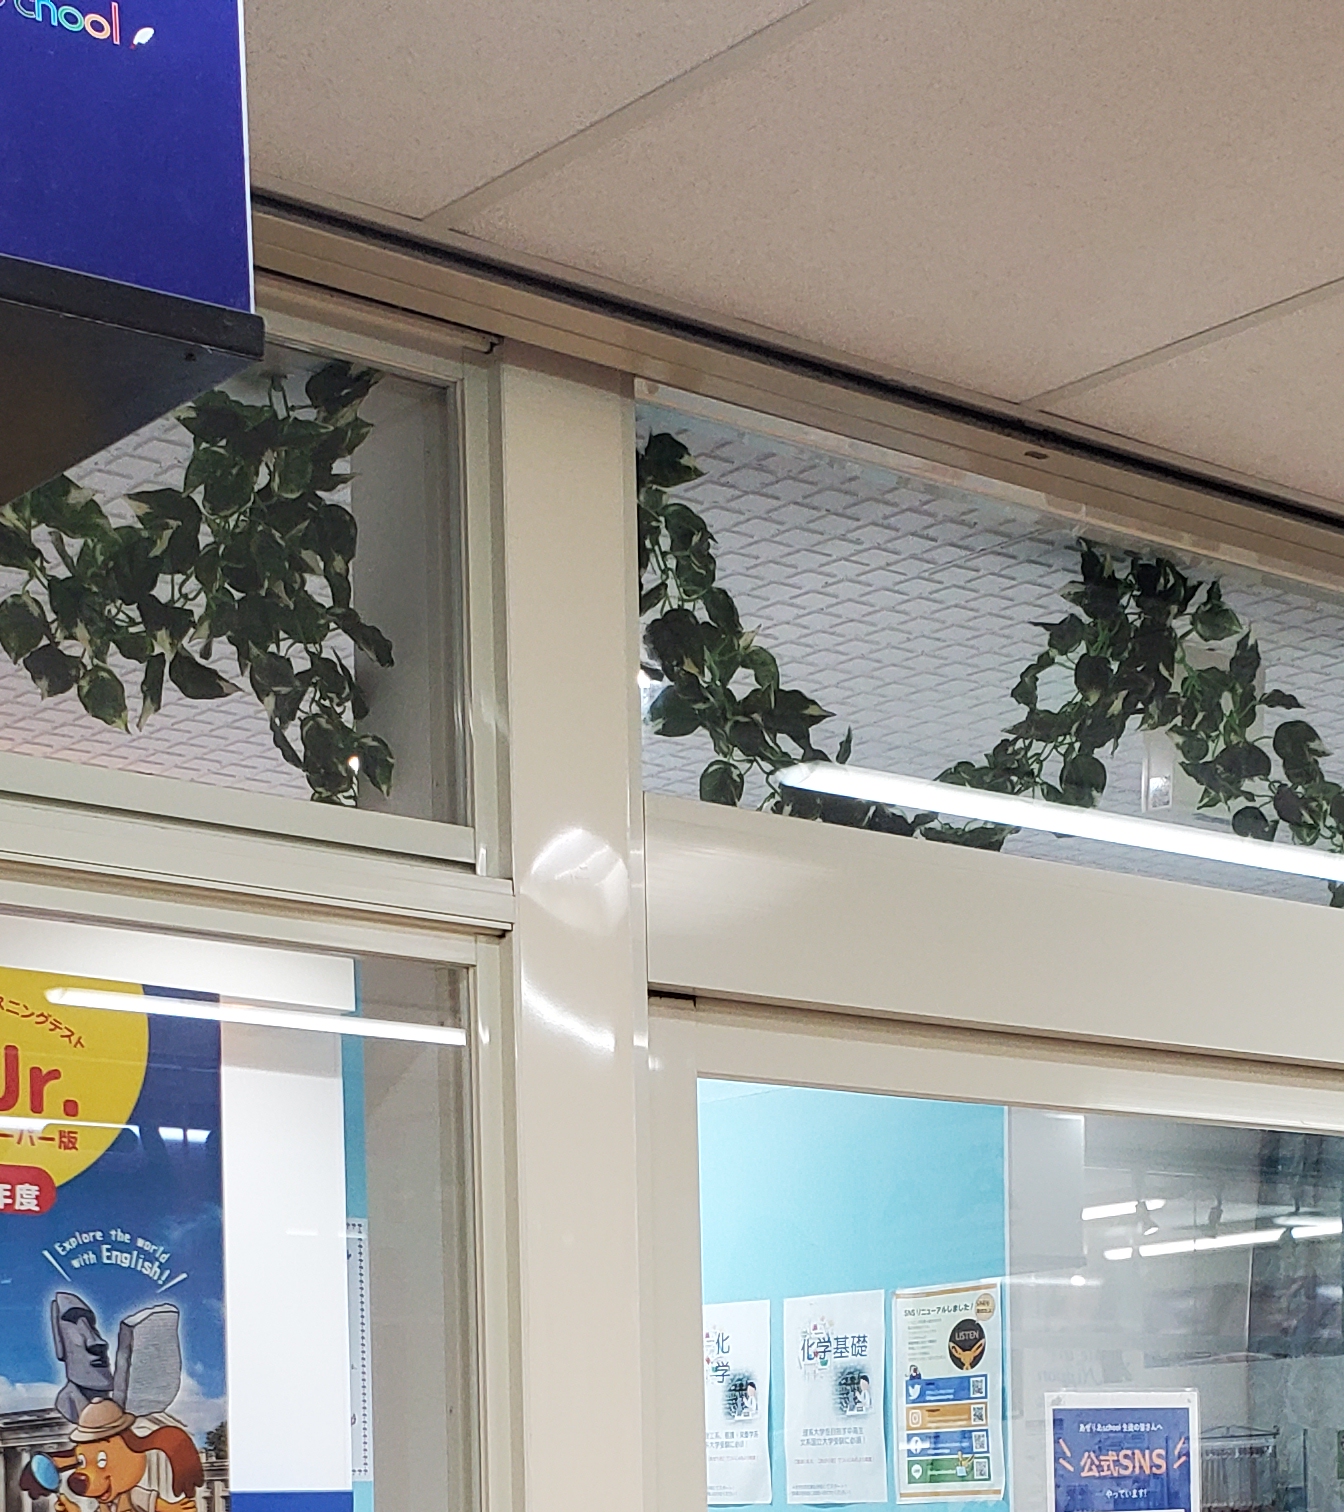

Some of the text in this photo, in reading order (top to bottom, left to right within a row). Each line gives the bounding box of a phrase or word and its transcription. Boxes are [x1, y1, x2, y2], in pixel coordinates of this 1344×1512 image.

[54, 1228, 170, 1264] Explore the world
[71, 1244, 171, 1285] with English!
[801, 1334, 868, 1361] 化学基礎
[955, 1331, 979, 1341] LISTEN
[1080, 1449, 1167, 1477] 公式SNS
